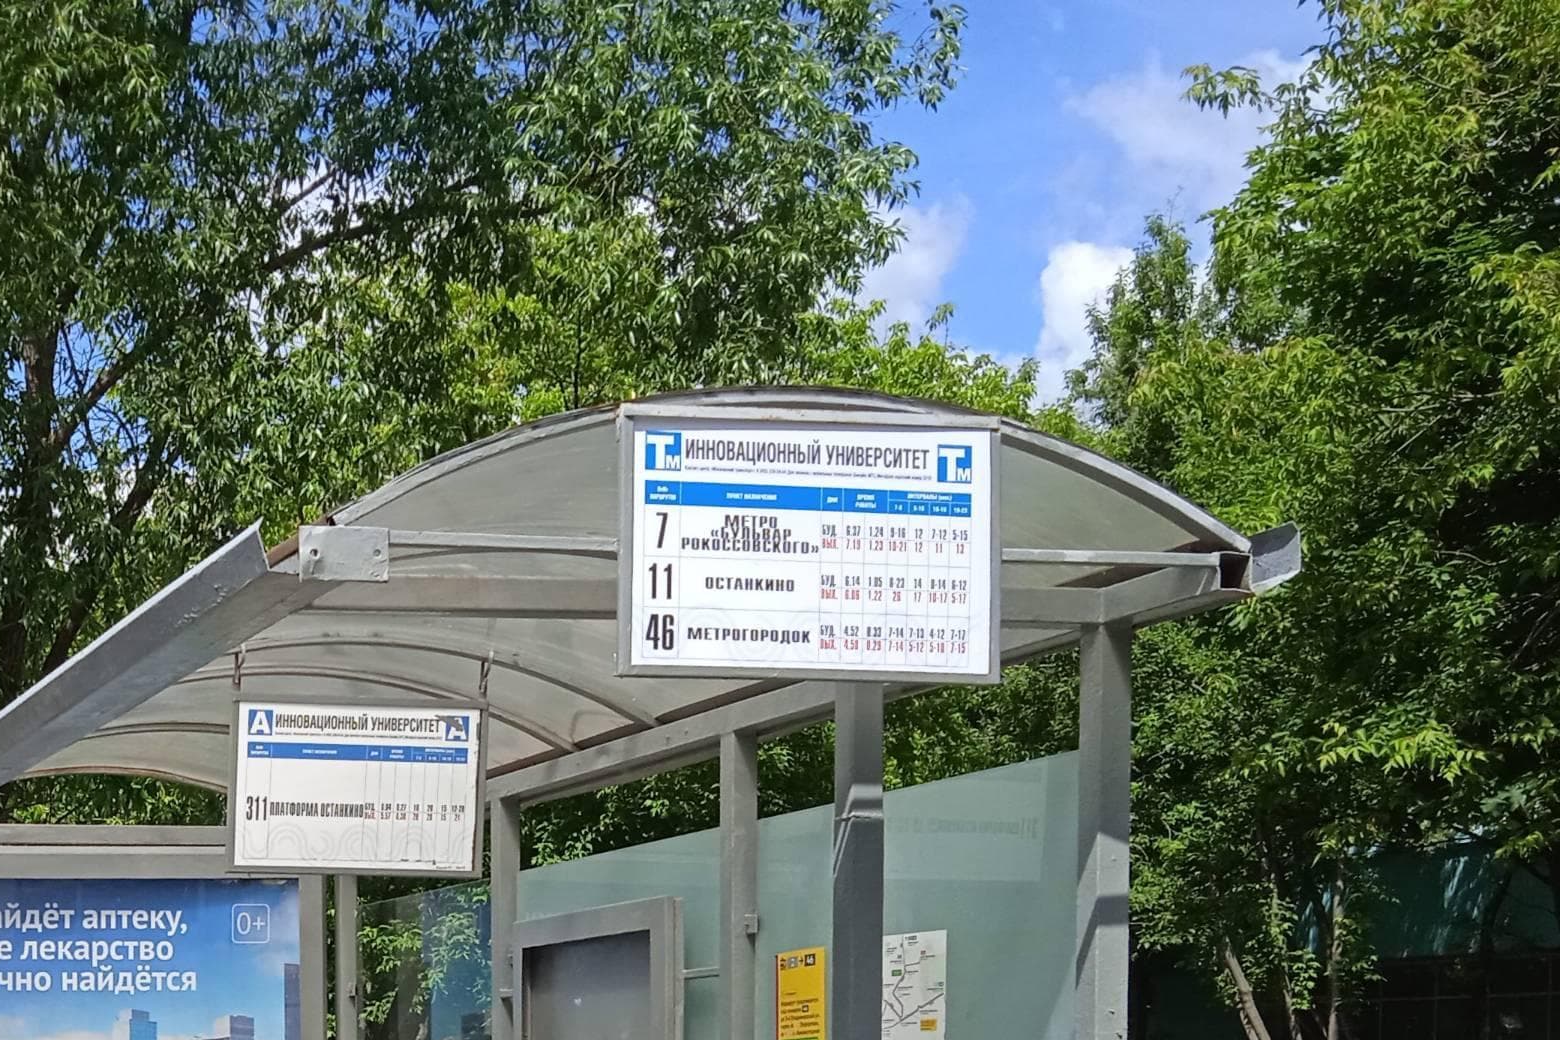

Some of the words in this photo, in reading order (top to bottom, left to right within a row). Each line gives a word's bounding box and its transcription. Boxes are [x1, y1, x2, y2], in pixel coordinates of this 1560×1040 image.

[685, 438, 821, 465] ИННОВАЦИОННЫЙ
[825, 445, 930, 469] УНИВЕРСИТЕТ
[656, 512, 669, 548] 7
[724, 514, 778, 529] МЕТРО
[915, 528, 923, 539] 12
[931, 528, 947, 540] 7-12
[952, 529, 969, 541] 5-15
[682, 537, 819, 555] РОКОССОВСКОГО»
[915, 541, 923, 553] 12
[935, 543, 943, 553] 11
[648, 562, 673, 600] 11
[705, 576, 795, 592] ОСТАНКИНО
[914, 578, 922, 589] 14
[645, 613, 675, 651] 46
[687, 627, 811, 644] МЕТРОГОРОДОК
[275, 713, 368, 731] ИННОВАЦИОННЫЙ
[371, 716, 441, 733] УНИВЕРСИТЕТ
[246, 795, 268, 821] 311
[269, 801, 319, 816] ПЛАТФОРМА
[320, 803, 364, 818] ОСТАНКИНО
[81, 909, 189, 935] аптеку,
[236, 911, 266, 936] 0+
[20, 939, 175, 968] лекарство
[61, 965, 198, 996] найдётся
